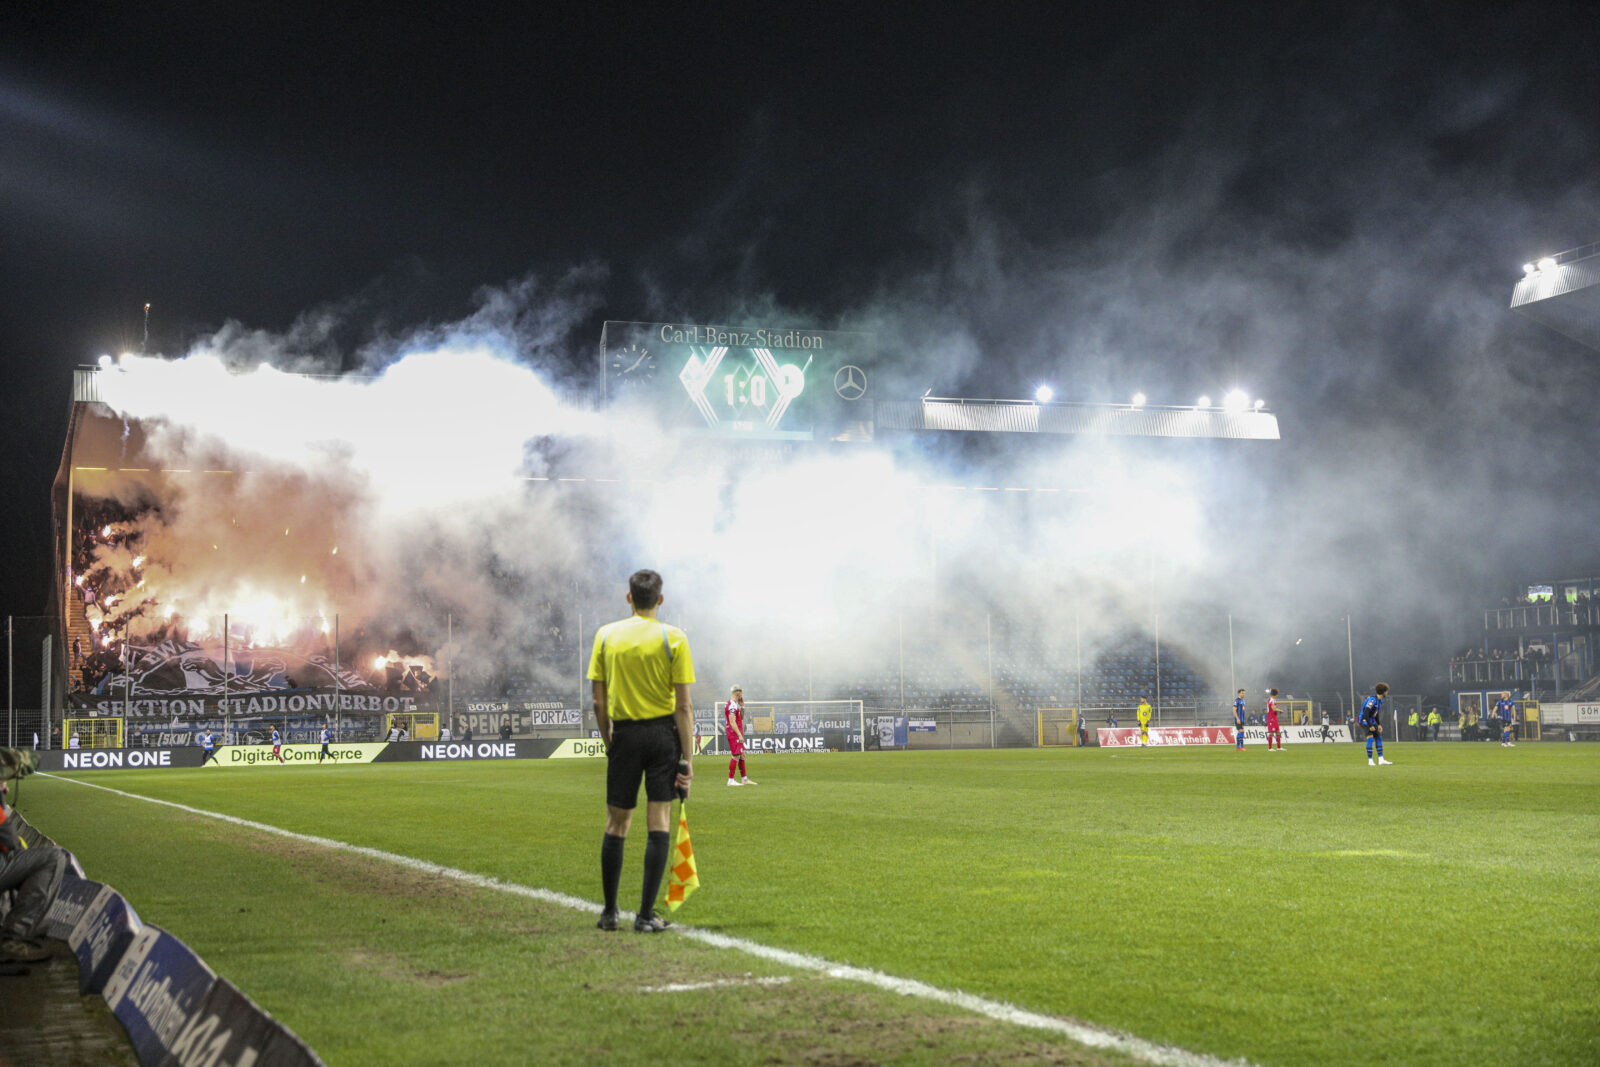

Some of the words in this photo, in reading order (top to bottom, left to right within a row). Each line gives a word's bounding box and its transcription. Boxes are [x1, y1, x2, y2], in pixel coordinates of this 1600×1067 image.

[660, 324, 824, 349] Carl-Benz-Stadion
[724, 374, 766, 406] 1:0
[97, 699, 205, 717] SEKTION
[217, 693, 415, 715] STADIONVERBOT
[533, 710, 568, 723] PORTA
[1165, 735, 1211, 744] Manheim
[1243, 729, 1289, 740] uhlsrt
[1298, 729, 1344, 739] uhlsort
[573, 742, 605, 756] Digit
[743, 737, 786, 749] NEON
[789, 737, 824, 748] ONE
[231, 748, 279, 764] Digita
[421, 744, 474, 759] NEON
[477, 743, 516, 757] ONE
[64, 752, 124, 768] NEON
[128, 751, 171, 767] ONE
